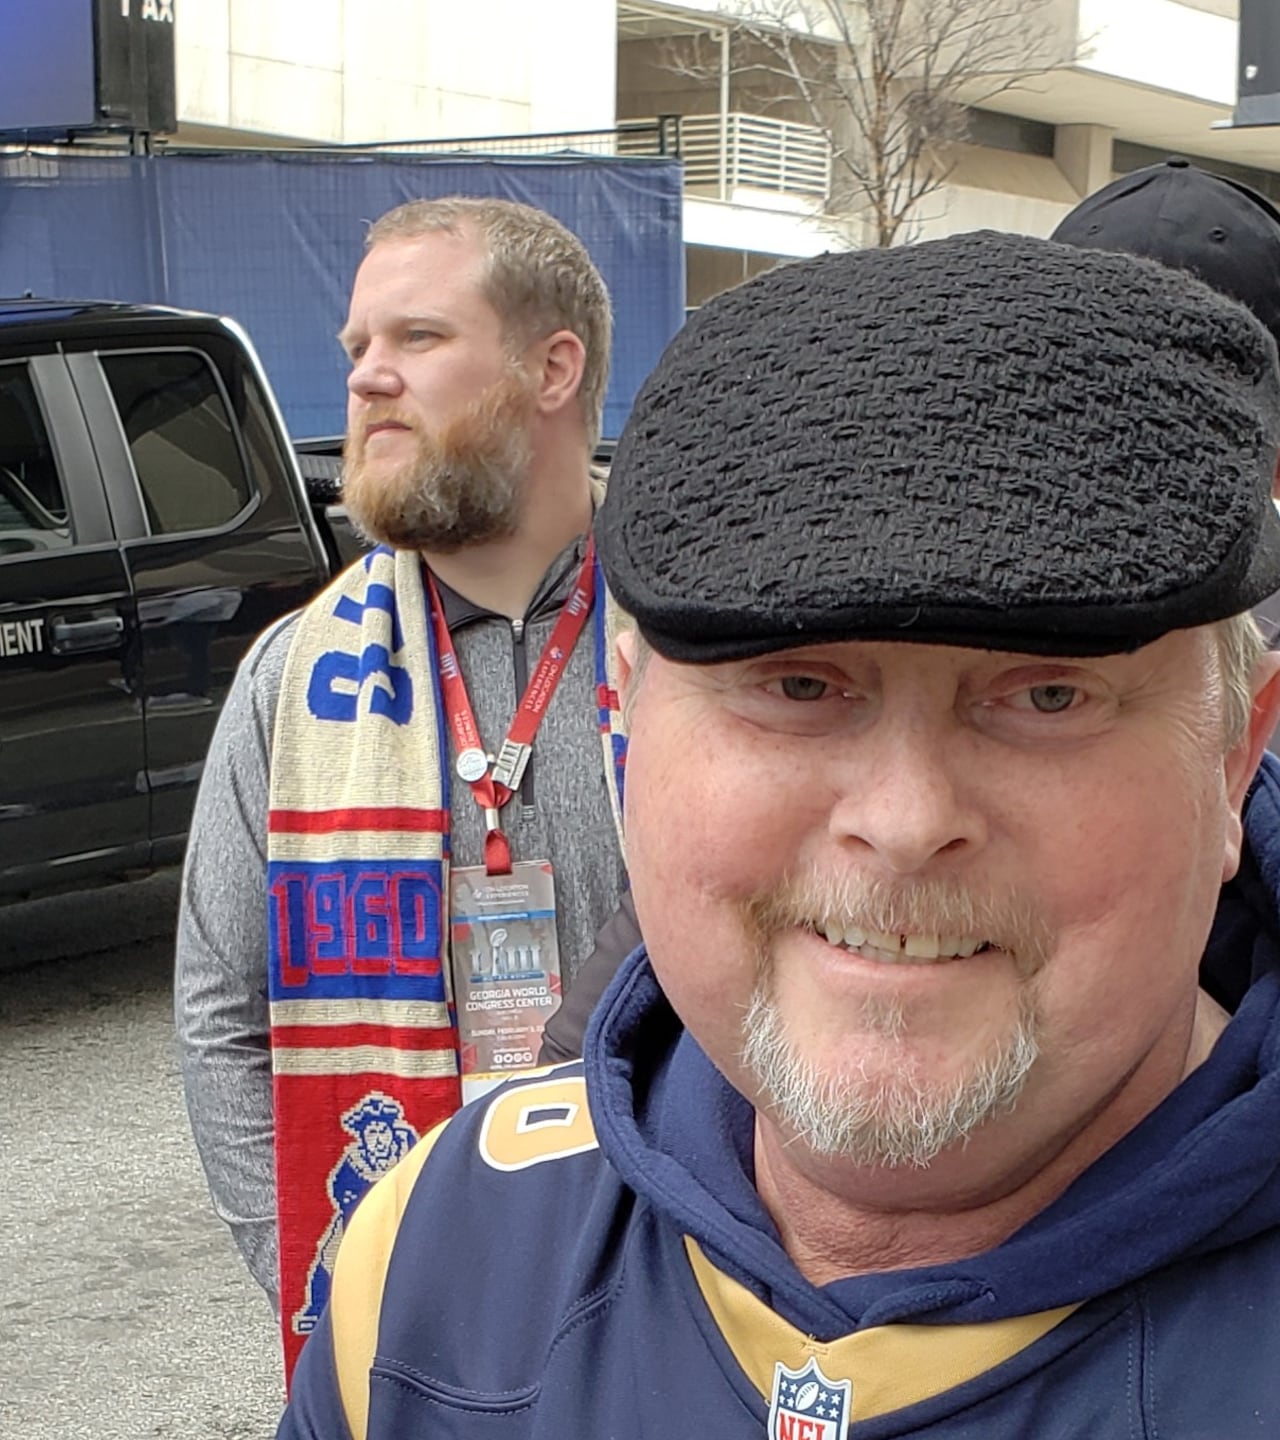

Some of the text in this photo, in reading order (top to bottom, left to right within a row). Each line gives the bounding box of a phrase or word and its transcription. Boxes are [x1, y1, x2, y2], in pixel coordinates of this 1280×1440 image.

[269, 872, 443, 987] 1960
[470, 986, 547, 1000] GEORGIA WORLD
[466, 996, 552, 1011] CONGRESS CENTER
